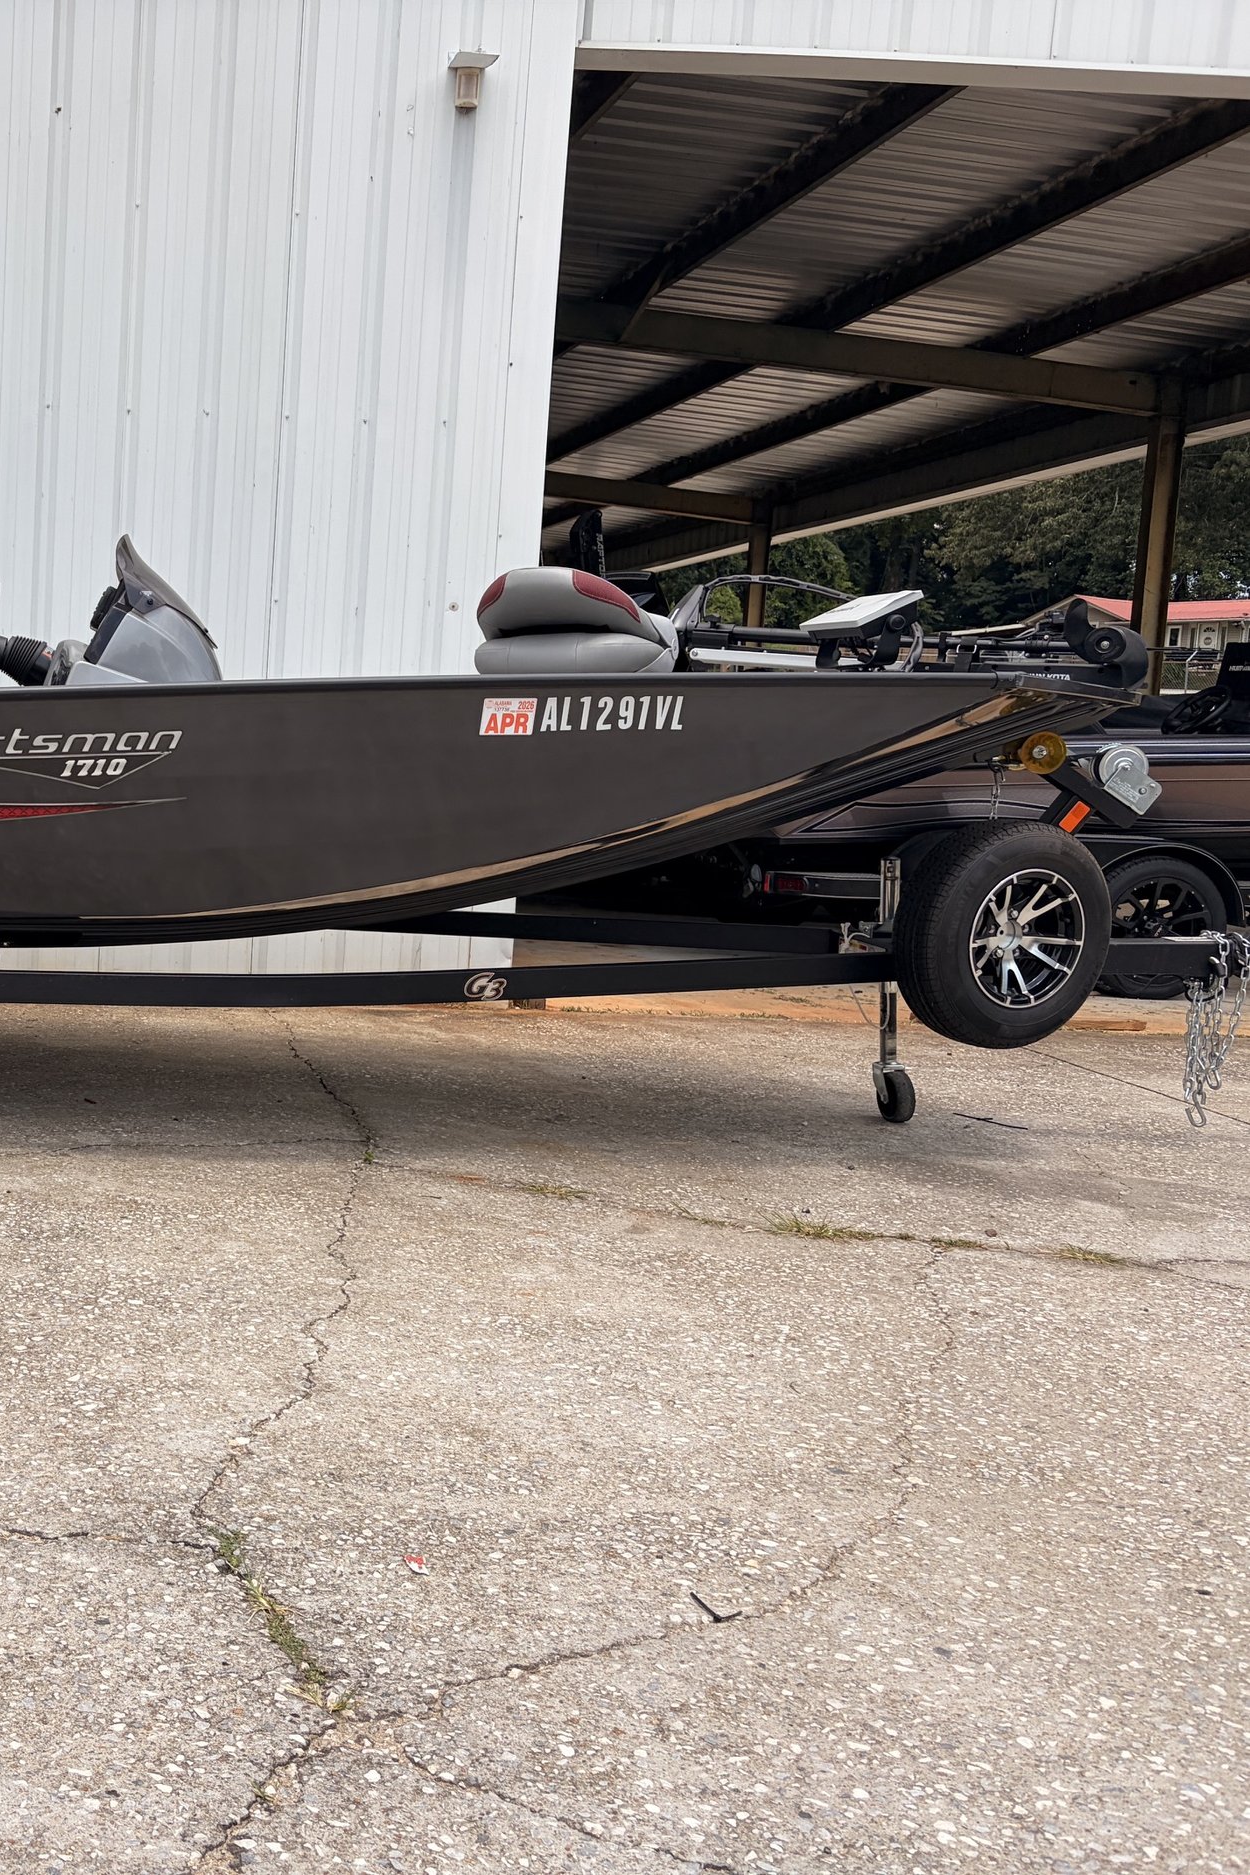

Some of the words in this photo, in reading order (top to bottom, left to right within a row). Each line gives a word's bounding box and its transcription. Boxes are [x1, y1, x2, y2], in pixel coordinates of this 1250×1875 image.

[517, 701, 535, 710] 2026
[484, 713, 529, 734] APR
[60, 758, 127, 777] 1710
[463, 971, 507, 1000] G3
